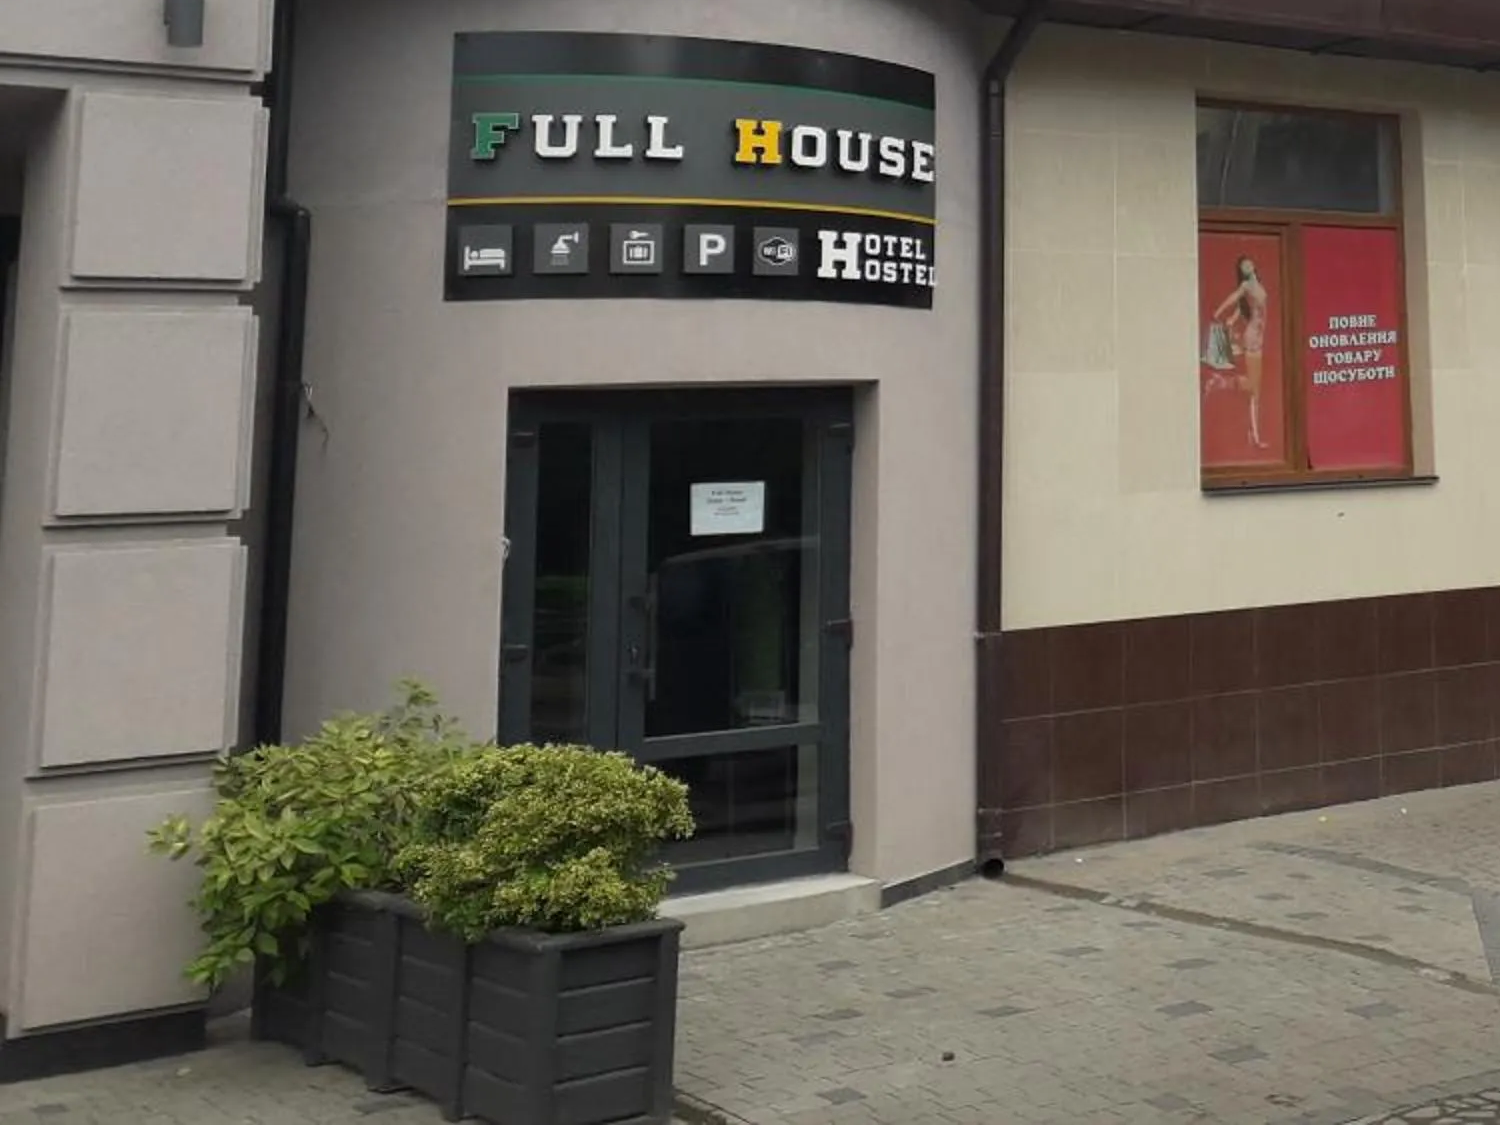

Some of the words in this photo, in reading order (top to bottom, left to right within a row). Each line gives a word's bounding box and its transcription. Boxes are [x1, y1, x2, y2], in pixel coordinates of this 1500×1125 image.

[471, 112, 684, 161] FULL
[734, 117, 936, 183] HOUSE
[1328, 315, 1377, 330] ПОВНЕ
[1309, 330, 1397, 348] ОНОВЛЕННЯ
[1325, 349, 1382, 366] ТОВАРУ
[1313, 366, 1396, 385] ЩОСУБОТИ
